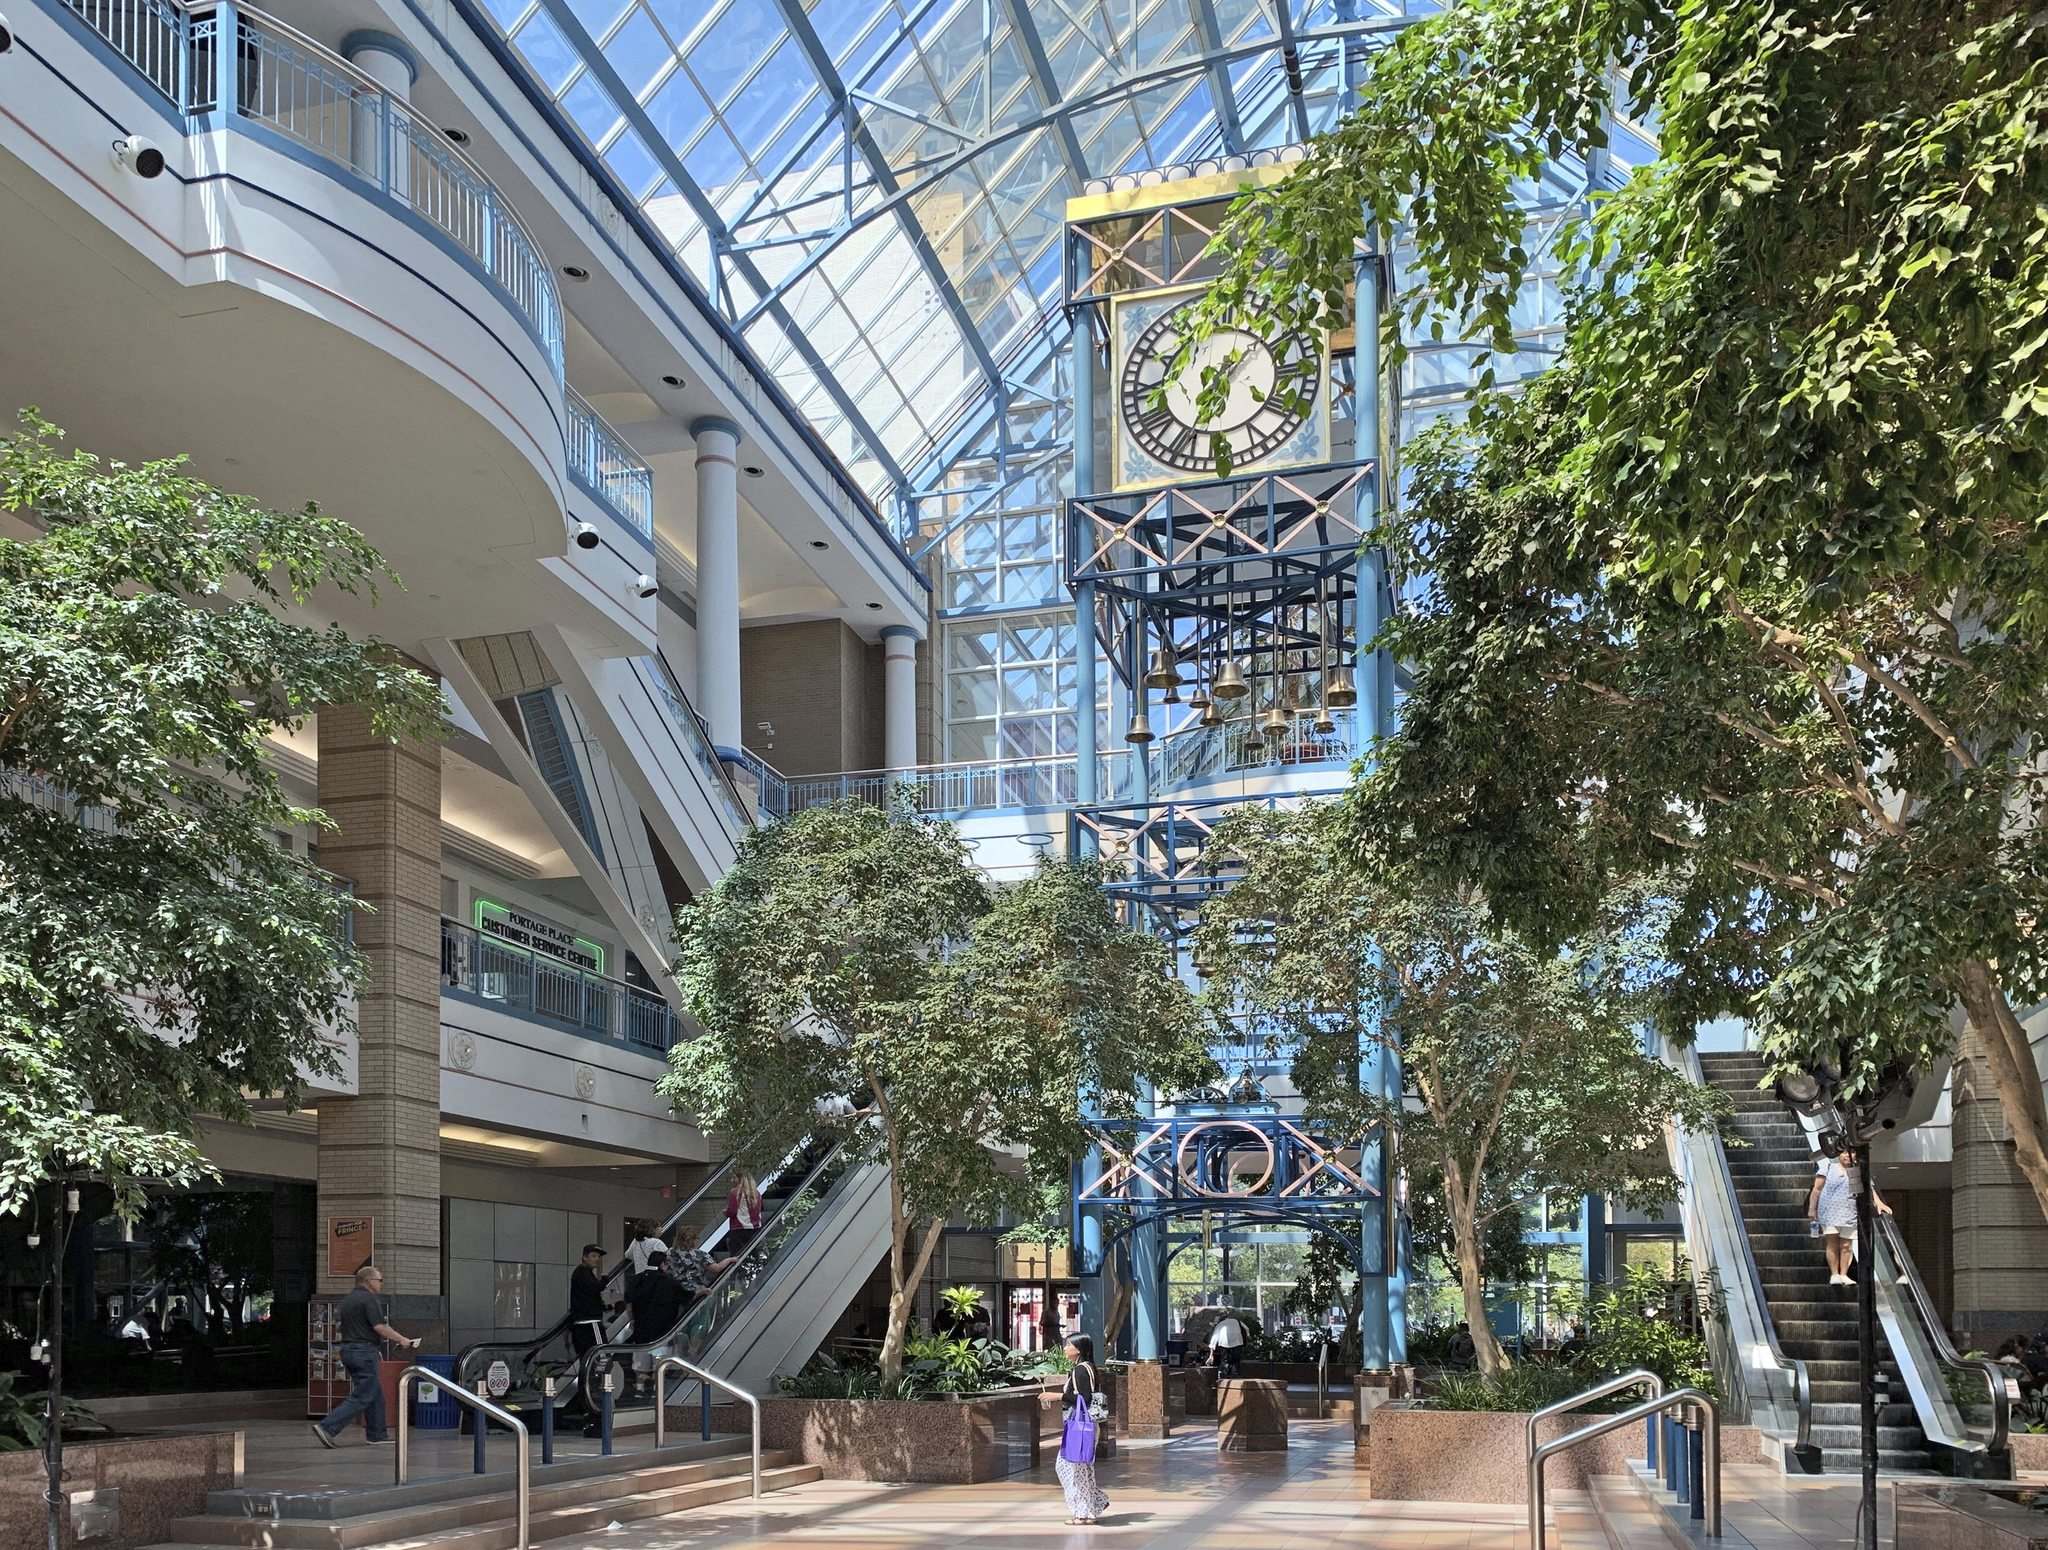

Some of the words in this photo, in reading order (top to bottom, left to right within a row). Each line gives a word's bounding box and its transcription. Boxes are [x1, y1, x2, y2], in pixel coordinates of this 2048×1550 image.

[482, 916, 530, 946] CUSTOMER
[532, 935, 567, 959] SERVICE
[567, 950, 597, 971] CENTRE
[509, 911, 547, 936] PORTAGE
[548, 927, 574, 946] PLACE
